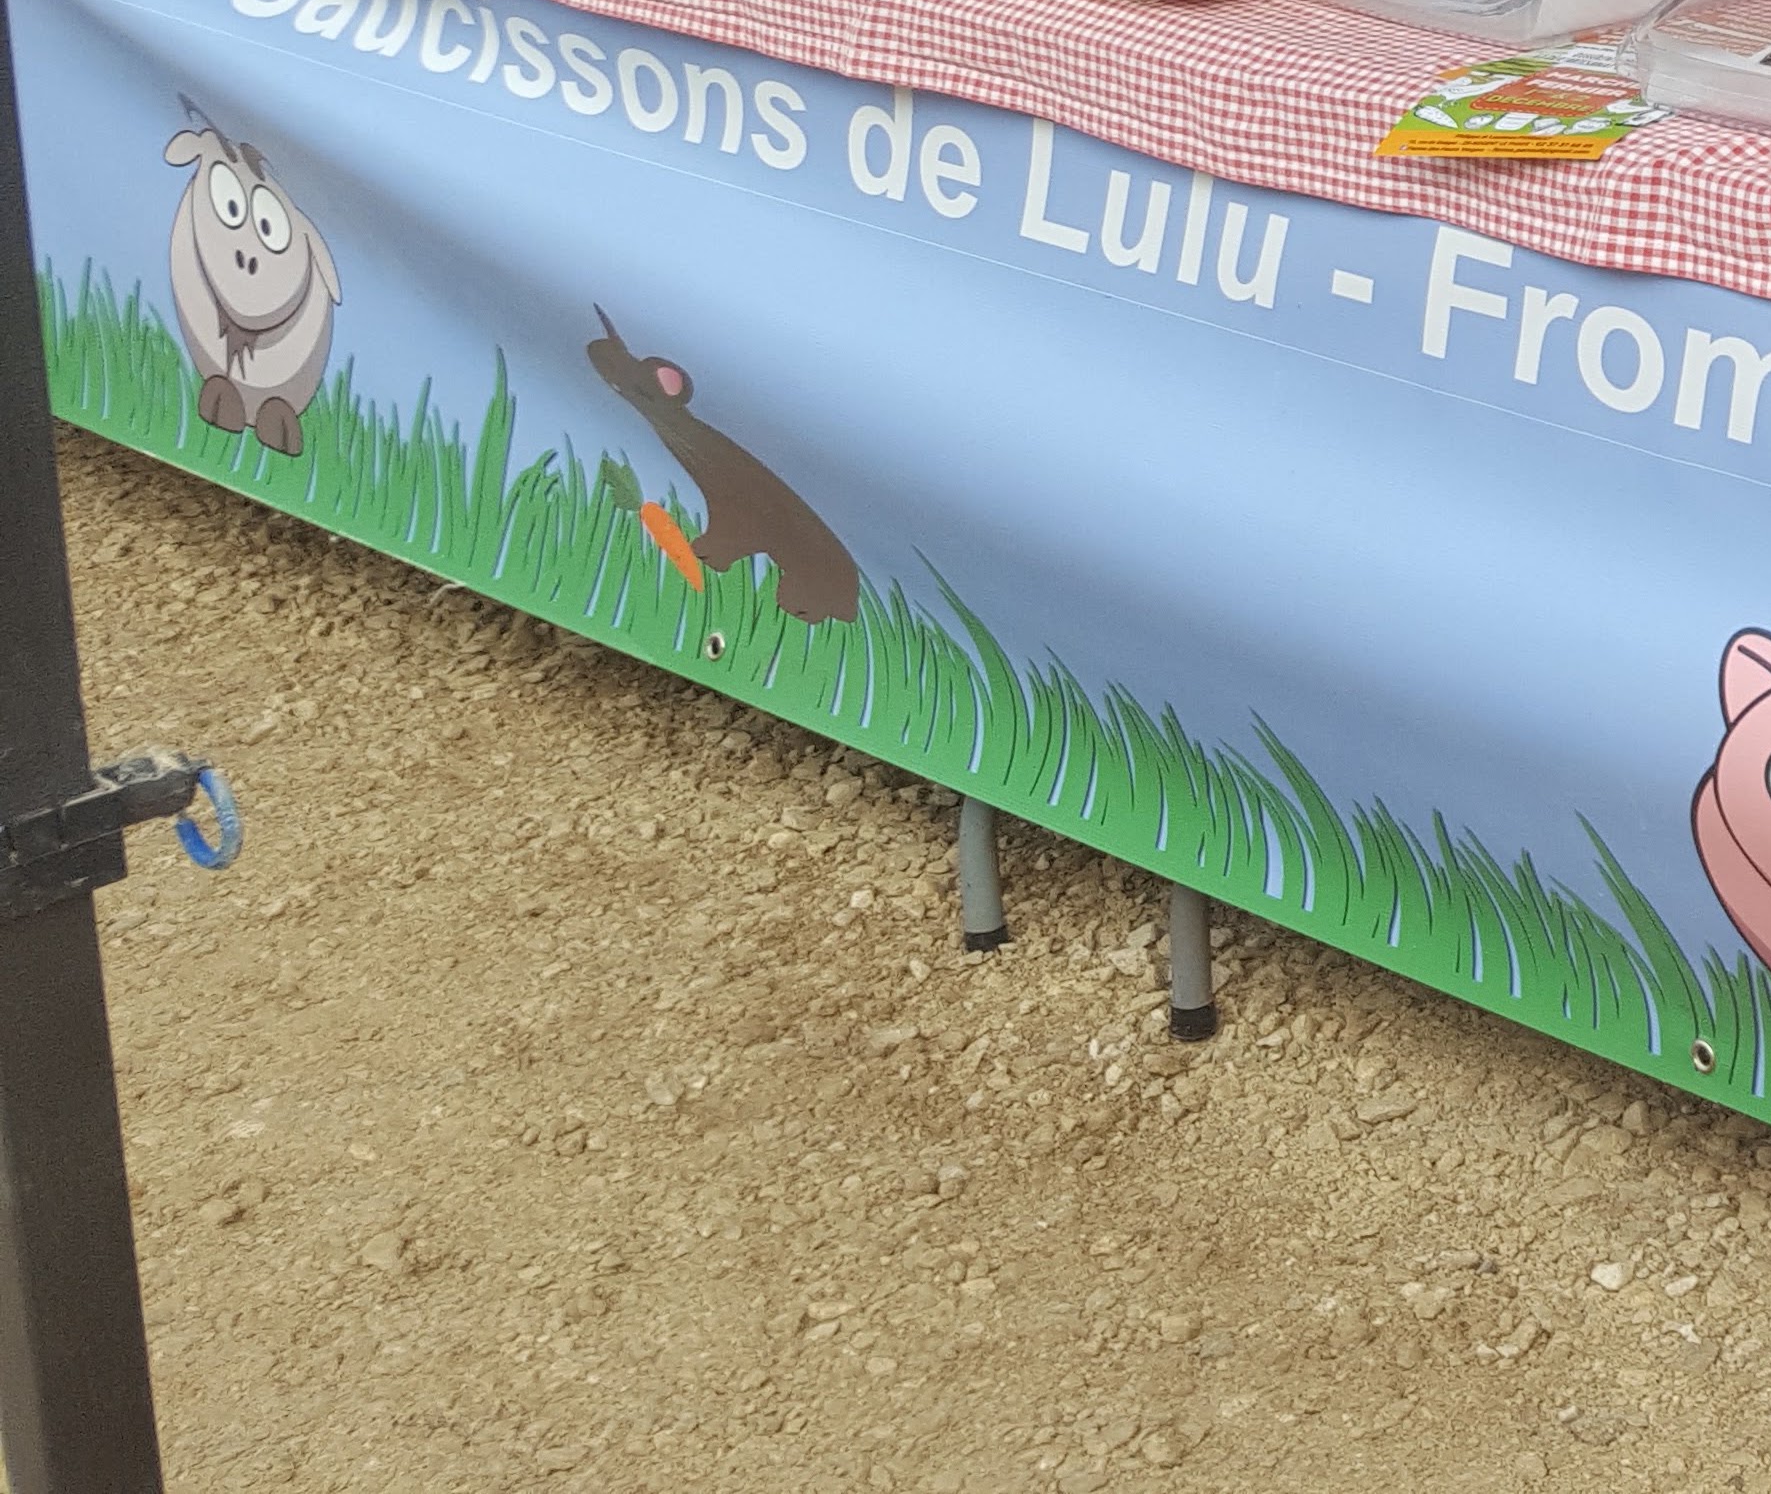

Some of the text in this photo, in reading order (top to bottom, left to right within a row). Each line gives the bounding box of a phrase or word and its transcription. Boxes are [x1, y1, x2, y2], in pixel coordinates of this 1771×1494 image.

[1524, 78, 1628, 99] FERMIER
[848, 84, 985, 221] de
[1017, 113, 1291, 309] Lulu
[1331, 269, 1377, 305] -
